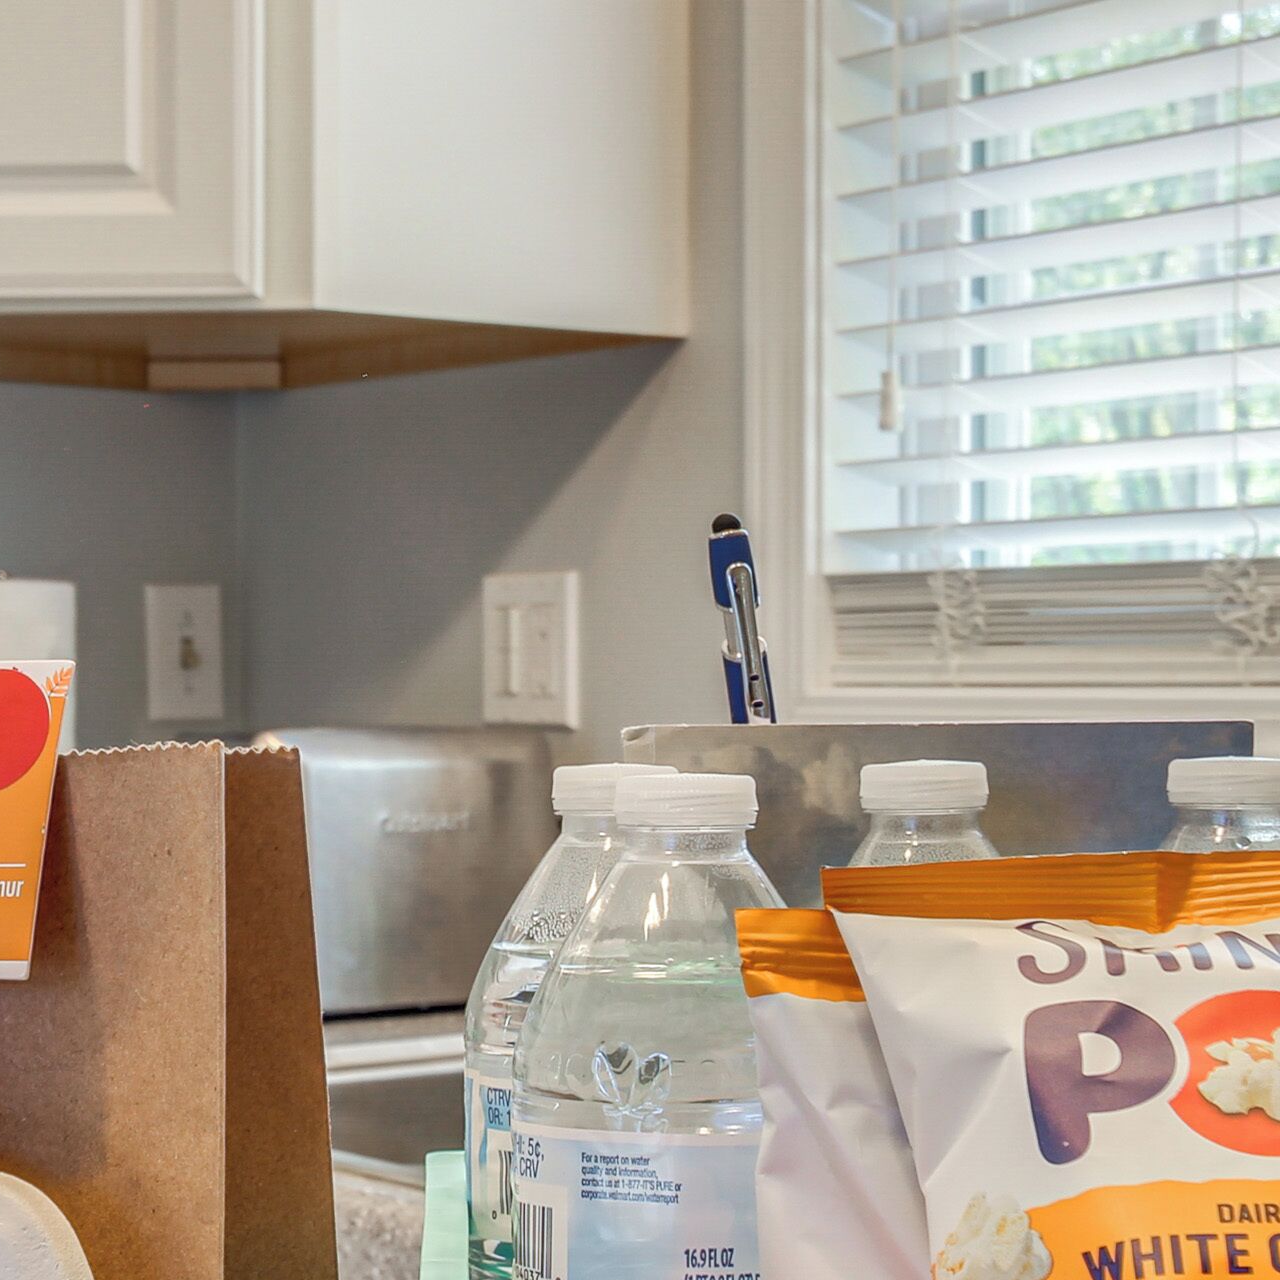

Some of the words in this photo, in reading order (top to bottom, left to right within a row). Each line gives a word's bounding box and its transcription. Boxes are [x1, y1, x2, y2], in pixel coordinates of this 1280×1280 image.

[581, 1151, 593, 1163] For
[599, 1154, 620, 1166] report
[620, 1156, 630, 1164] on
[630, 1156, 650, 1166] water
[519, 1156, 540, 1179] CRV
[604, 1166, 617, 1176] and
[674, 1182, 682, 1192] or
[684, 1249, 707, 1269] 16.9
[707, 1247, 720, 1268] FL
[720, 1247, 735, 1268] OZ
